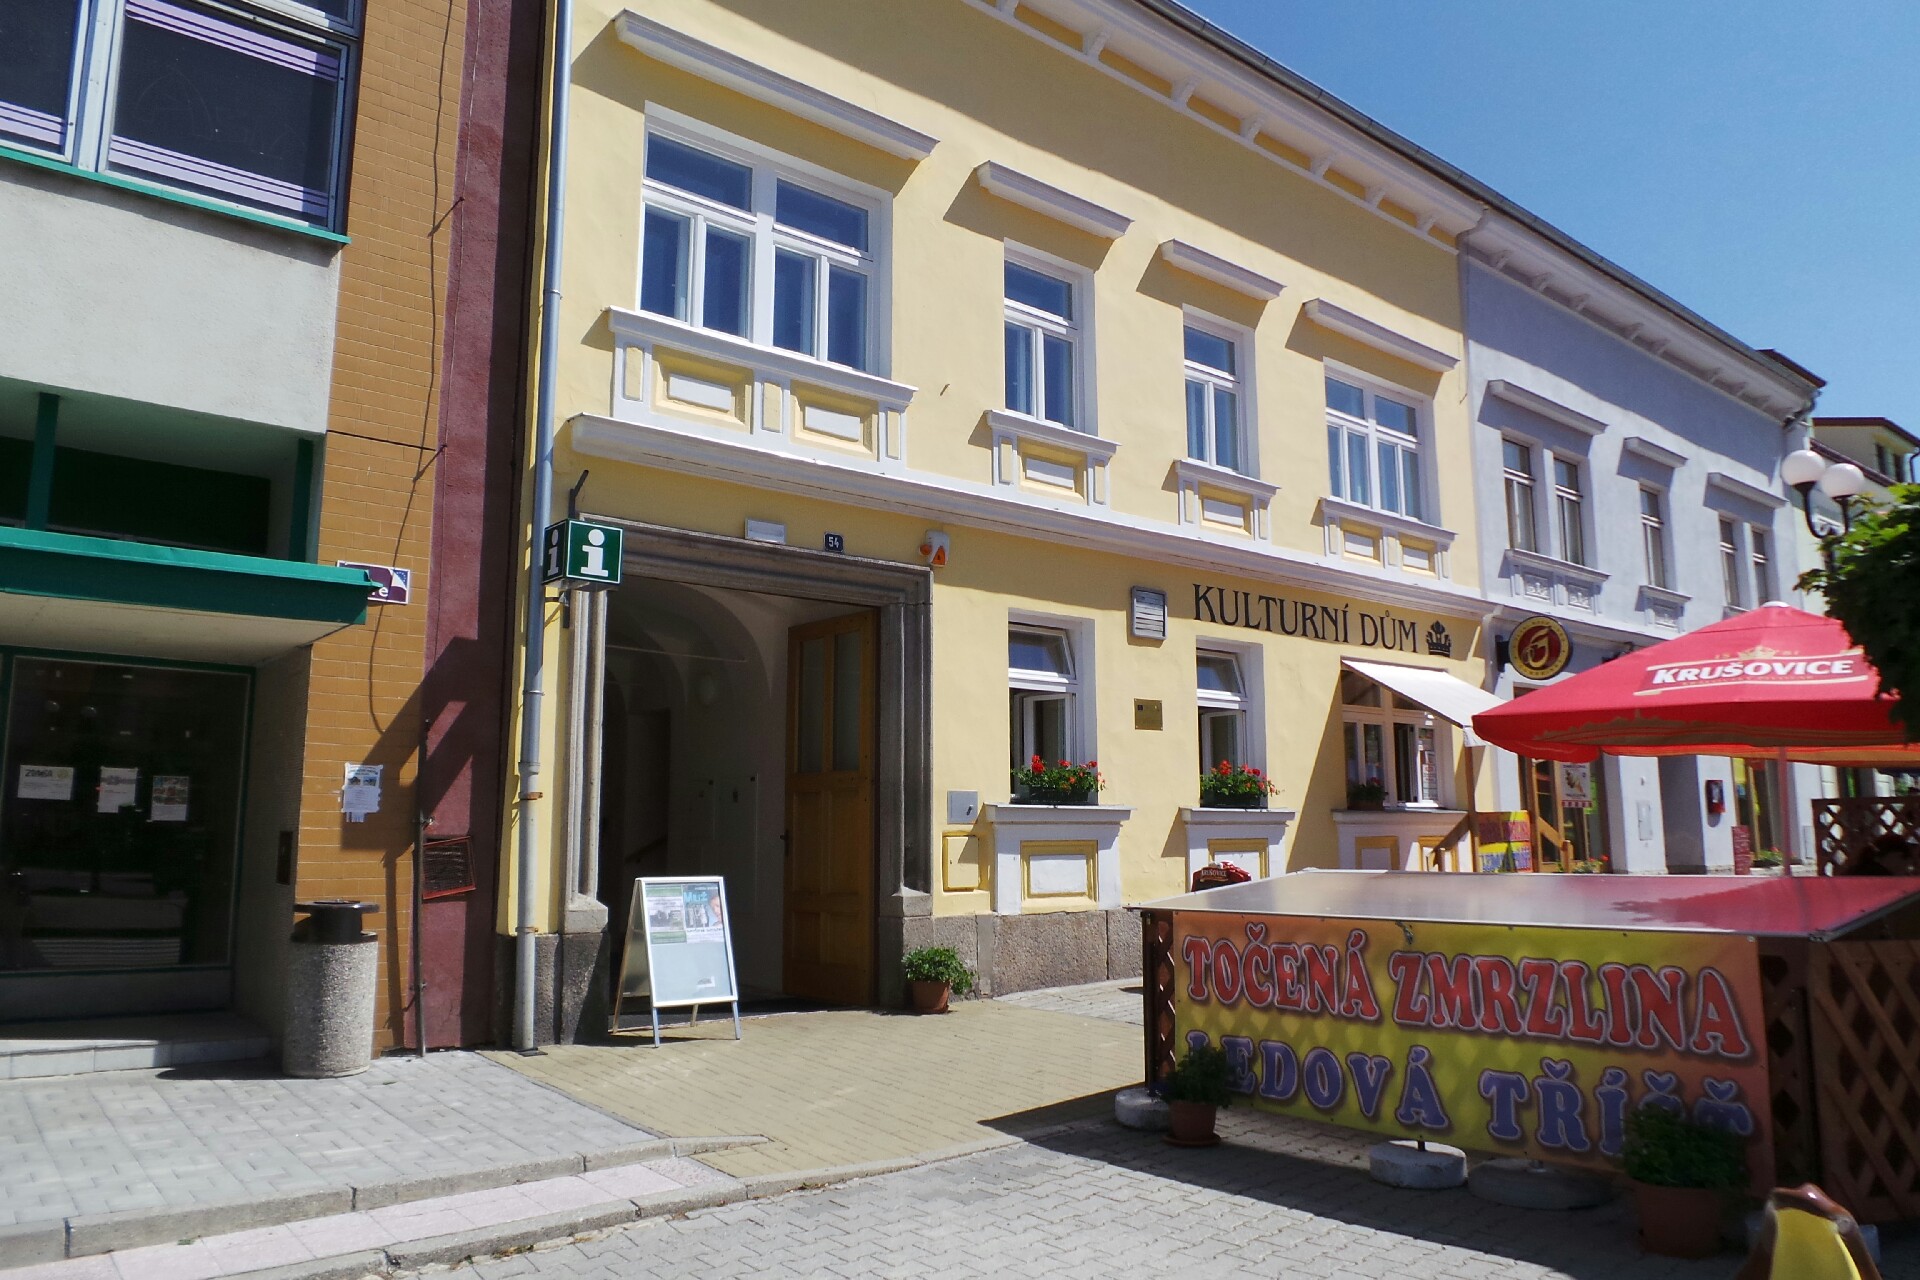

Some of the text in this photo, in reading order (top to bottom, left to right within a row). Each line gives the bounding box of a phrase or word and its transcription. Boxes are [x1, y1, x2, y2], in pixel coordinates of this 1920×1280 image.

[828, 536, 840, 549] 54
[1192, 583, 1418, 653] KULTURNÍ DŮM
[1652, 660, 1854, 684] KRUŠOVICE
[1183, 922, 1752, 1058] TOČENÁ ZMRZLINA
